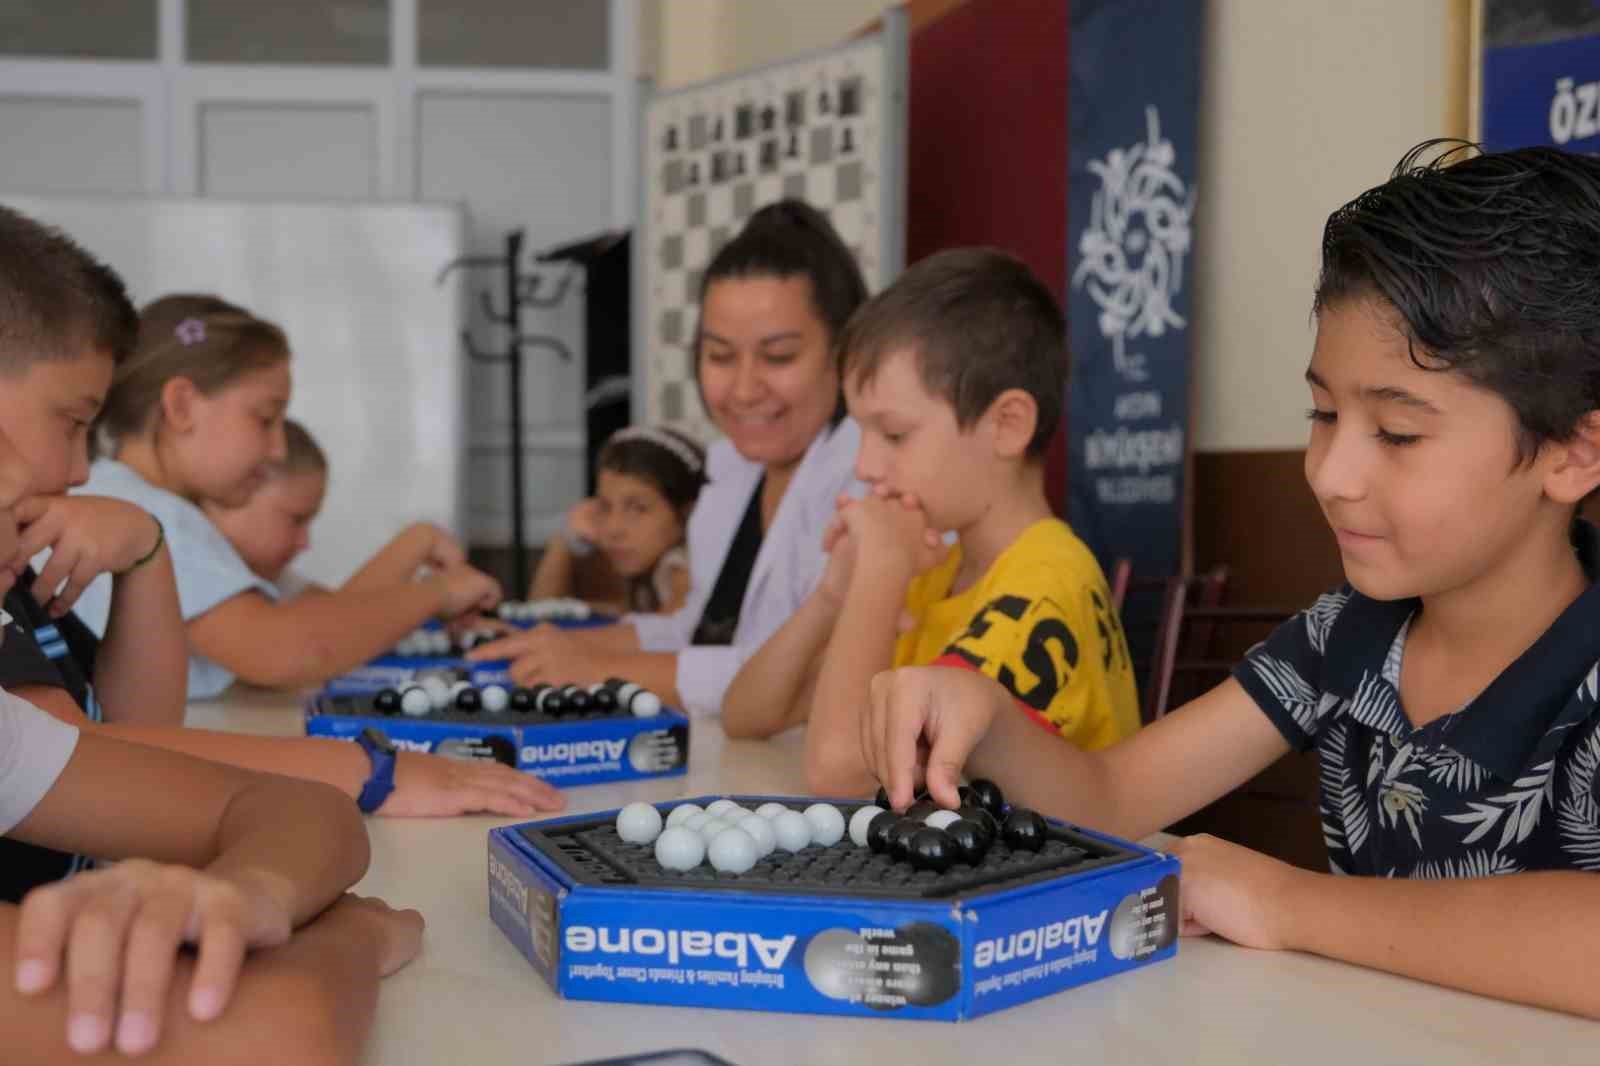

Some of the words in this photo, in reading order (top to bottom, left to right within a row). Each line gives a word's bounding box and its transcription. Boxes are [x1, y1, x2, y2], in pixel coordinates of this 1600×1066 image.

[1550, 77, 1600, 144] ÖZ
[521, 739, 627, 764] Abalone
[566, 926, 796, 969] Abalone
[973, 909, 1109, 968] Abalone
